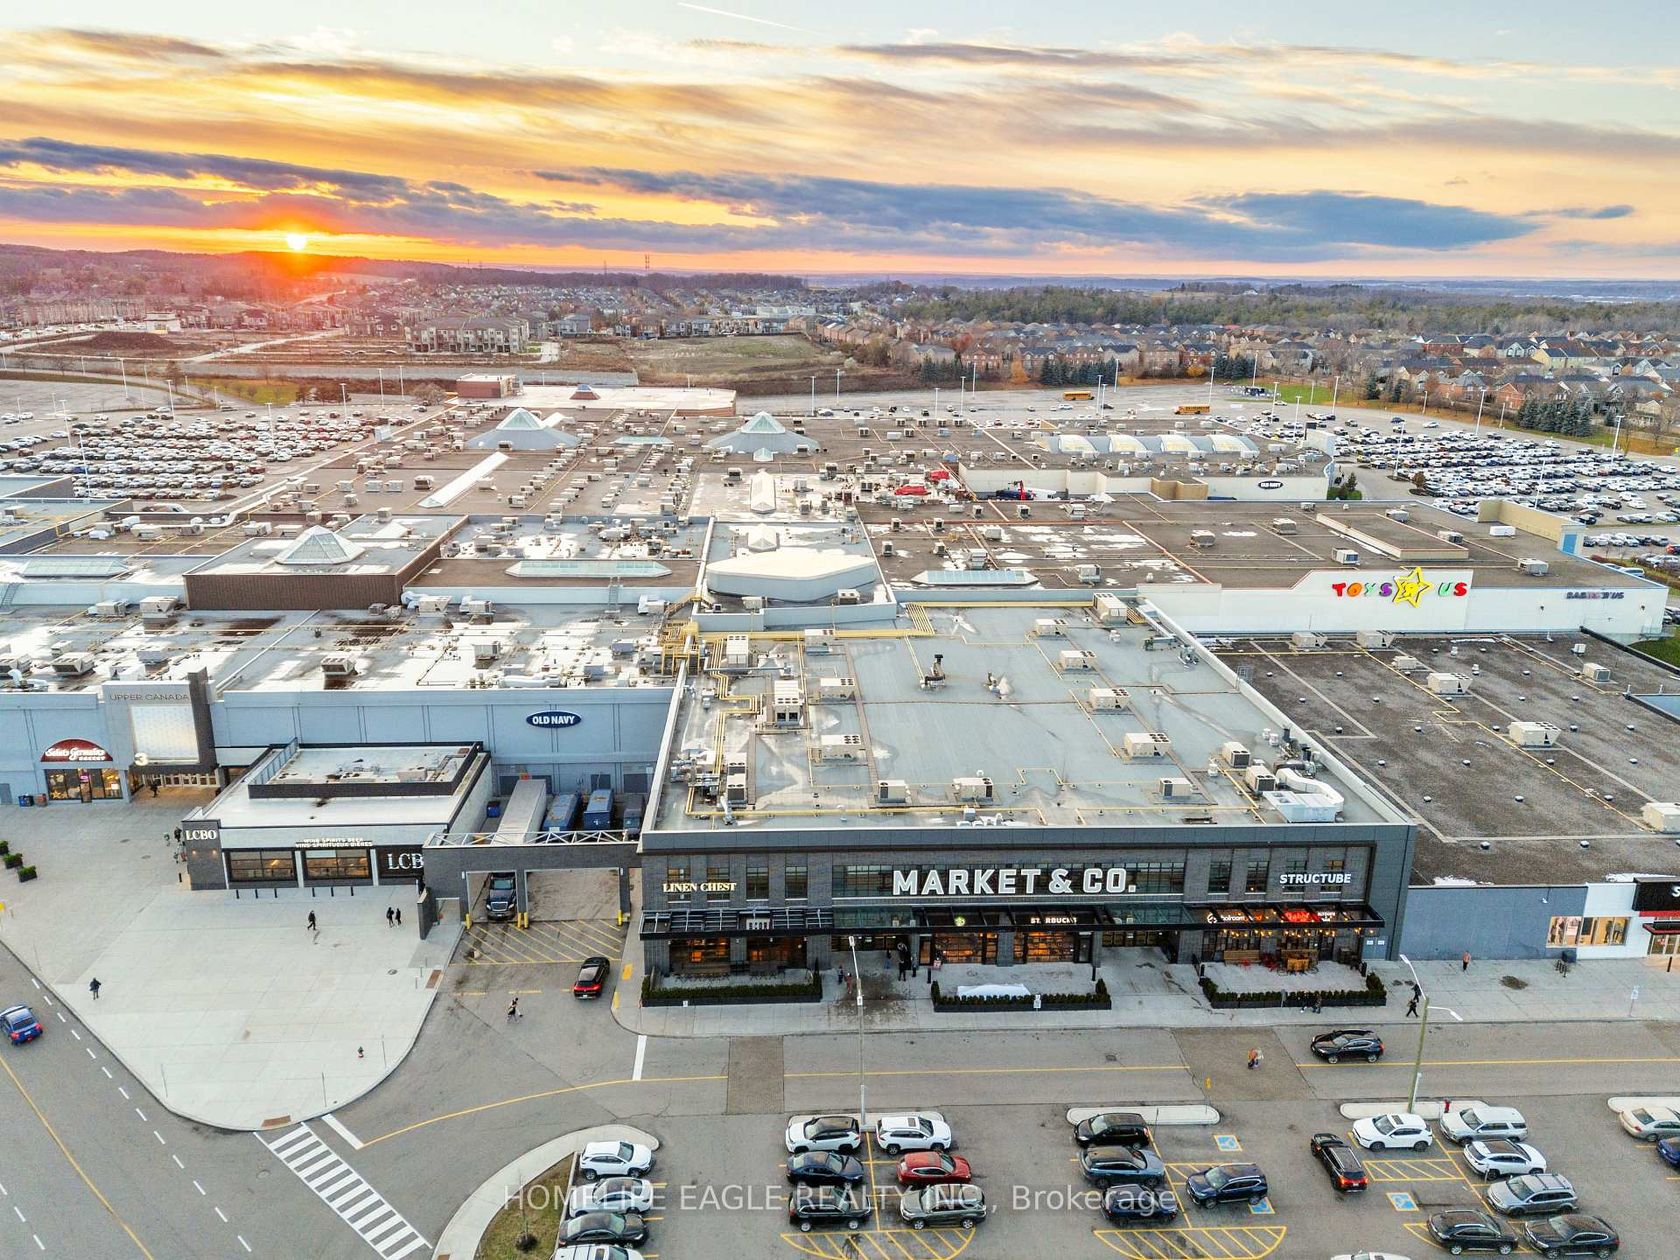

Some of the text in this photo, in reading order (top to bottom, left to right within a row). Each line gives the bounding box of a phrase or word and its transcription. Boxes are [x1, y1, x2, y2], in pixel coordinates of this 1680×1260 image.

[1332, 582, 1393, 597] TOYS
[1438, 582, 1467, 597] US
[532, 715, 575, 725] OLD NAVY
[134, 752, 149, 766] 3
[185, 829, 217, 840] LCBO
[387, 852, 424, 870] LCB
[892, 868, 1137, 896] MARKET & CO.
[1279, 873, 1352, 884] STRUCTUBE
[662, 882, 738, 893] LINEN CHEST
